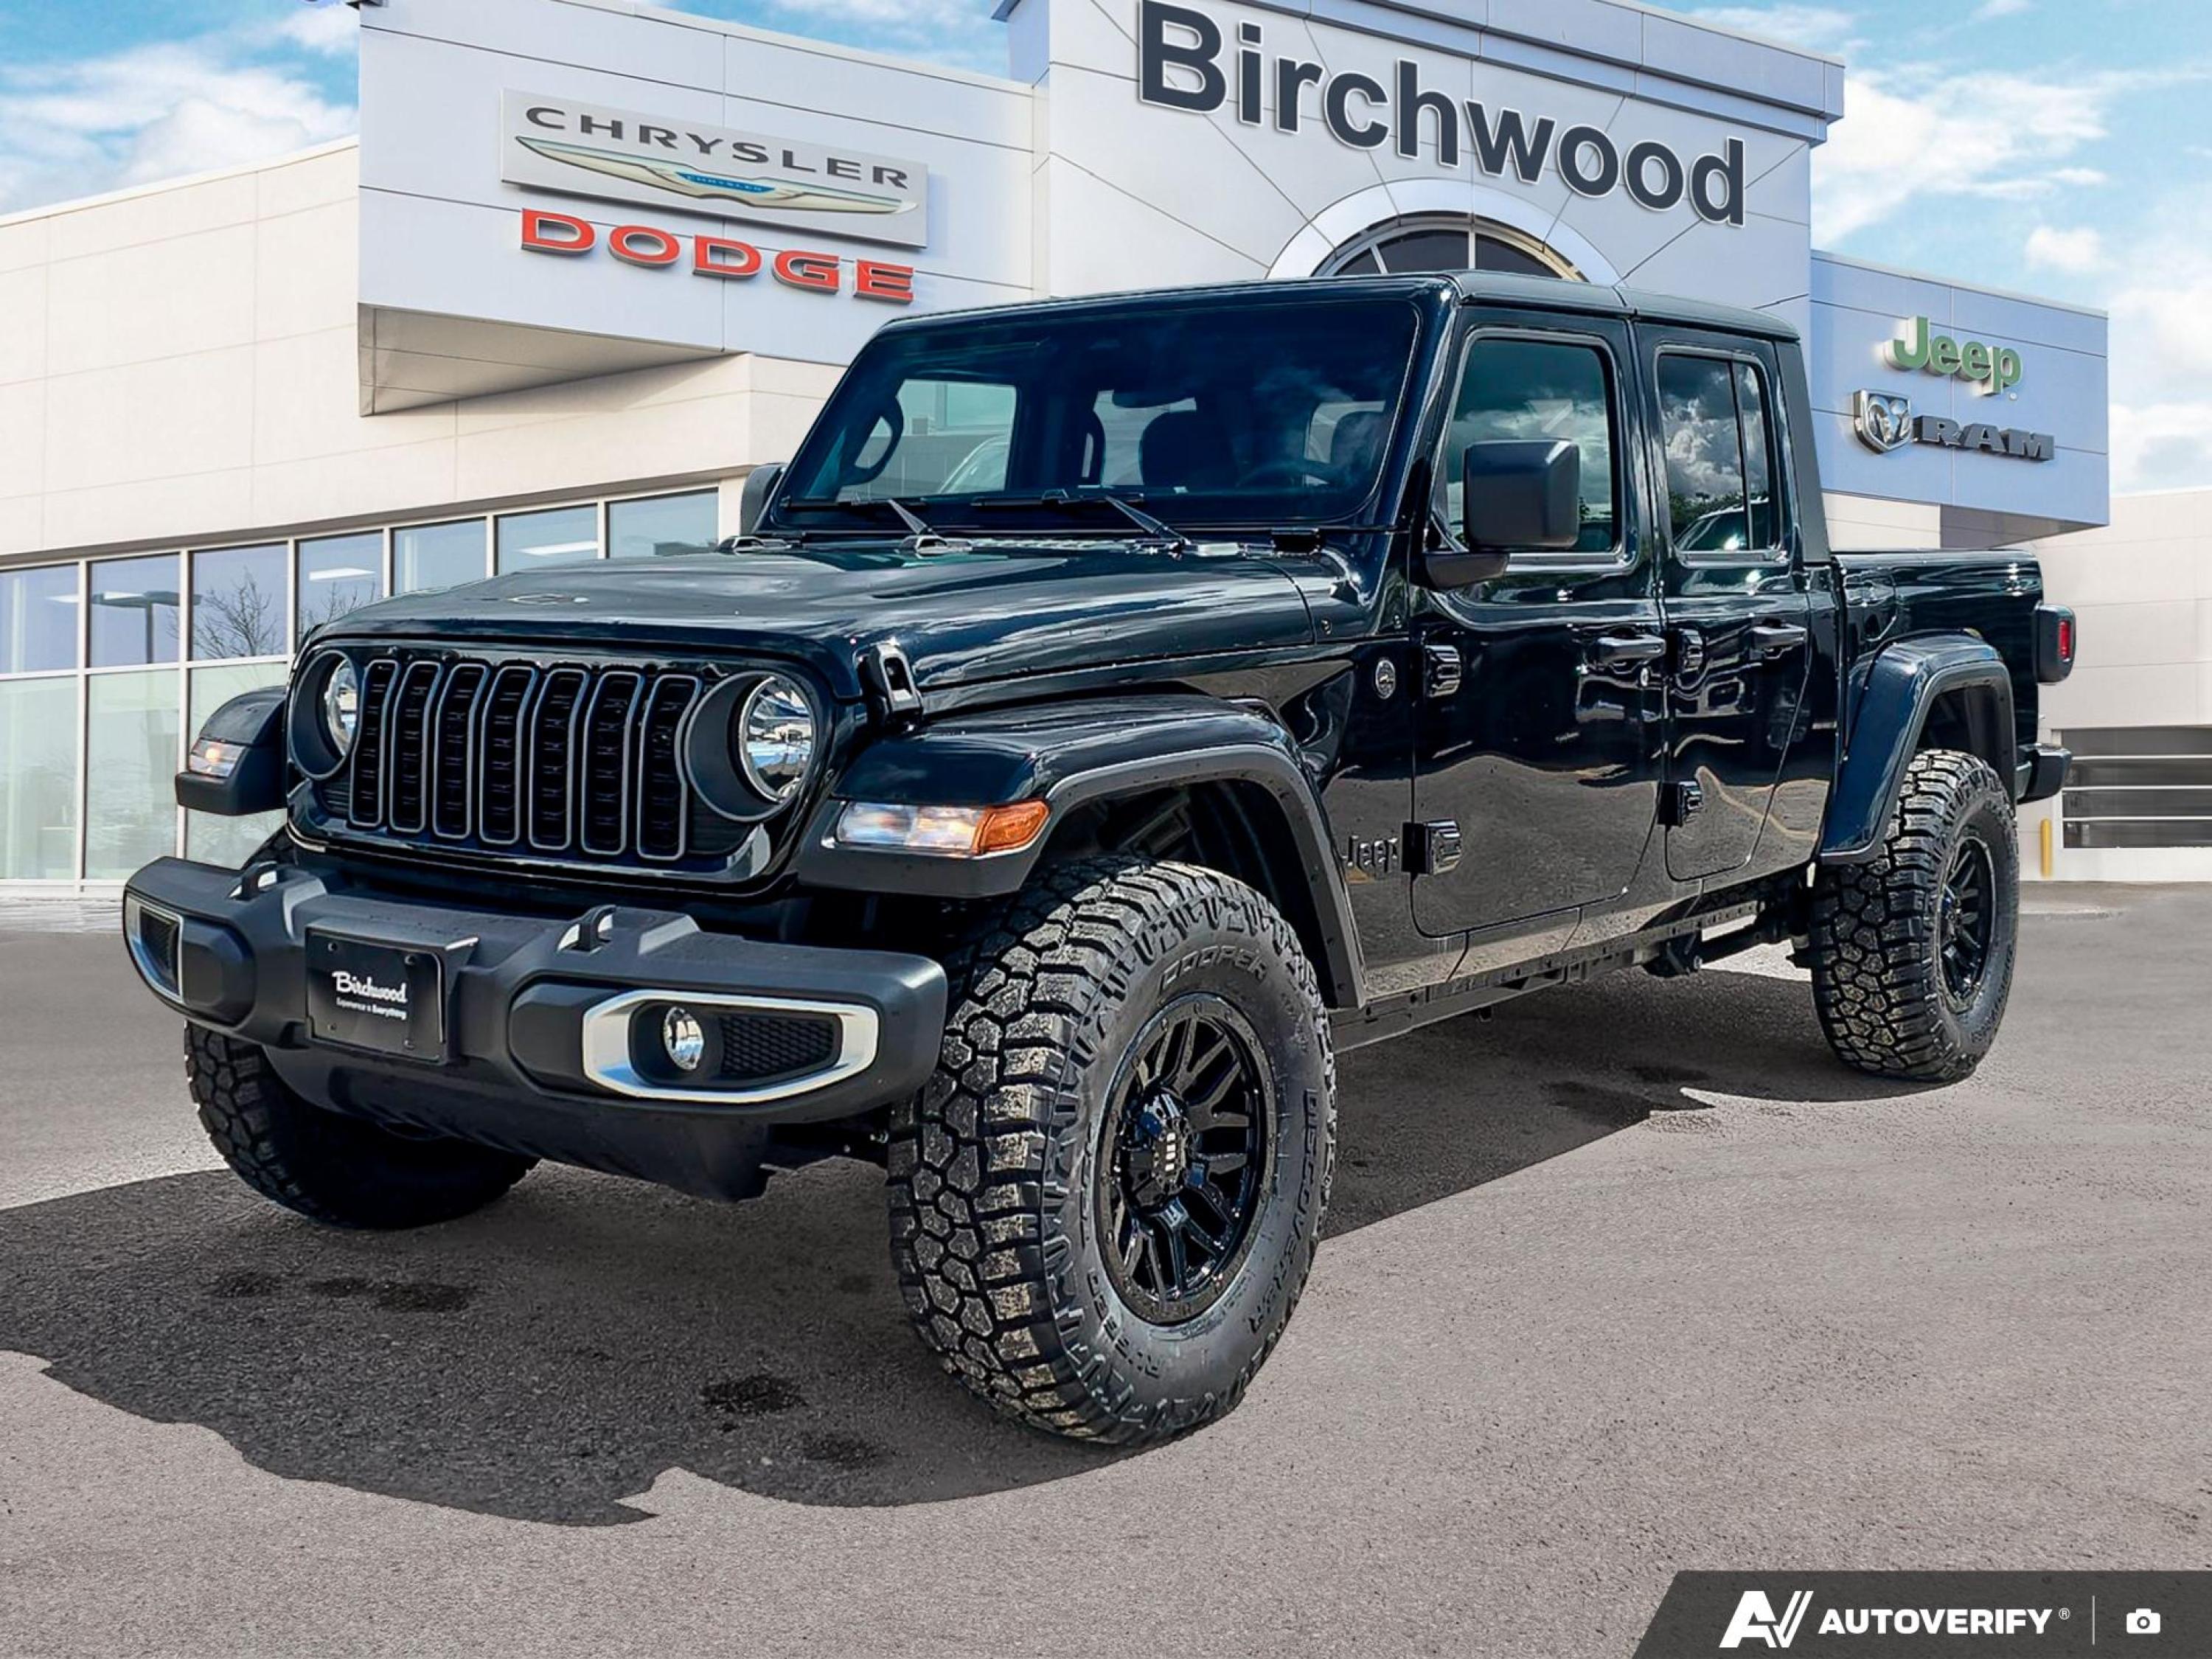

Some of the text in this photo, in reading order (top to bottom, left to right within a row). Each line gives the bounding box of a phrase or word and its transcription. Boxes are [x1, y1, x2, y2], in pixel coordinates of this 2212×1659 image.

[526, 106, 908, 189] CHRYSLER
[1138, 0, 1745, 227] Birchwood
[521, 208, 914, 303] DODGE
[1885, 315, 2023, 396] Jeep
[1912, 414, 2055, 462] RAM
